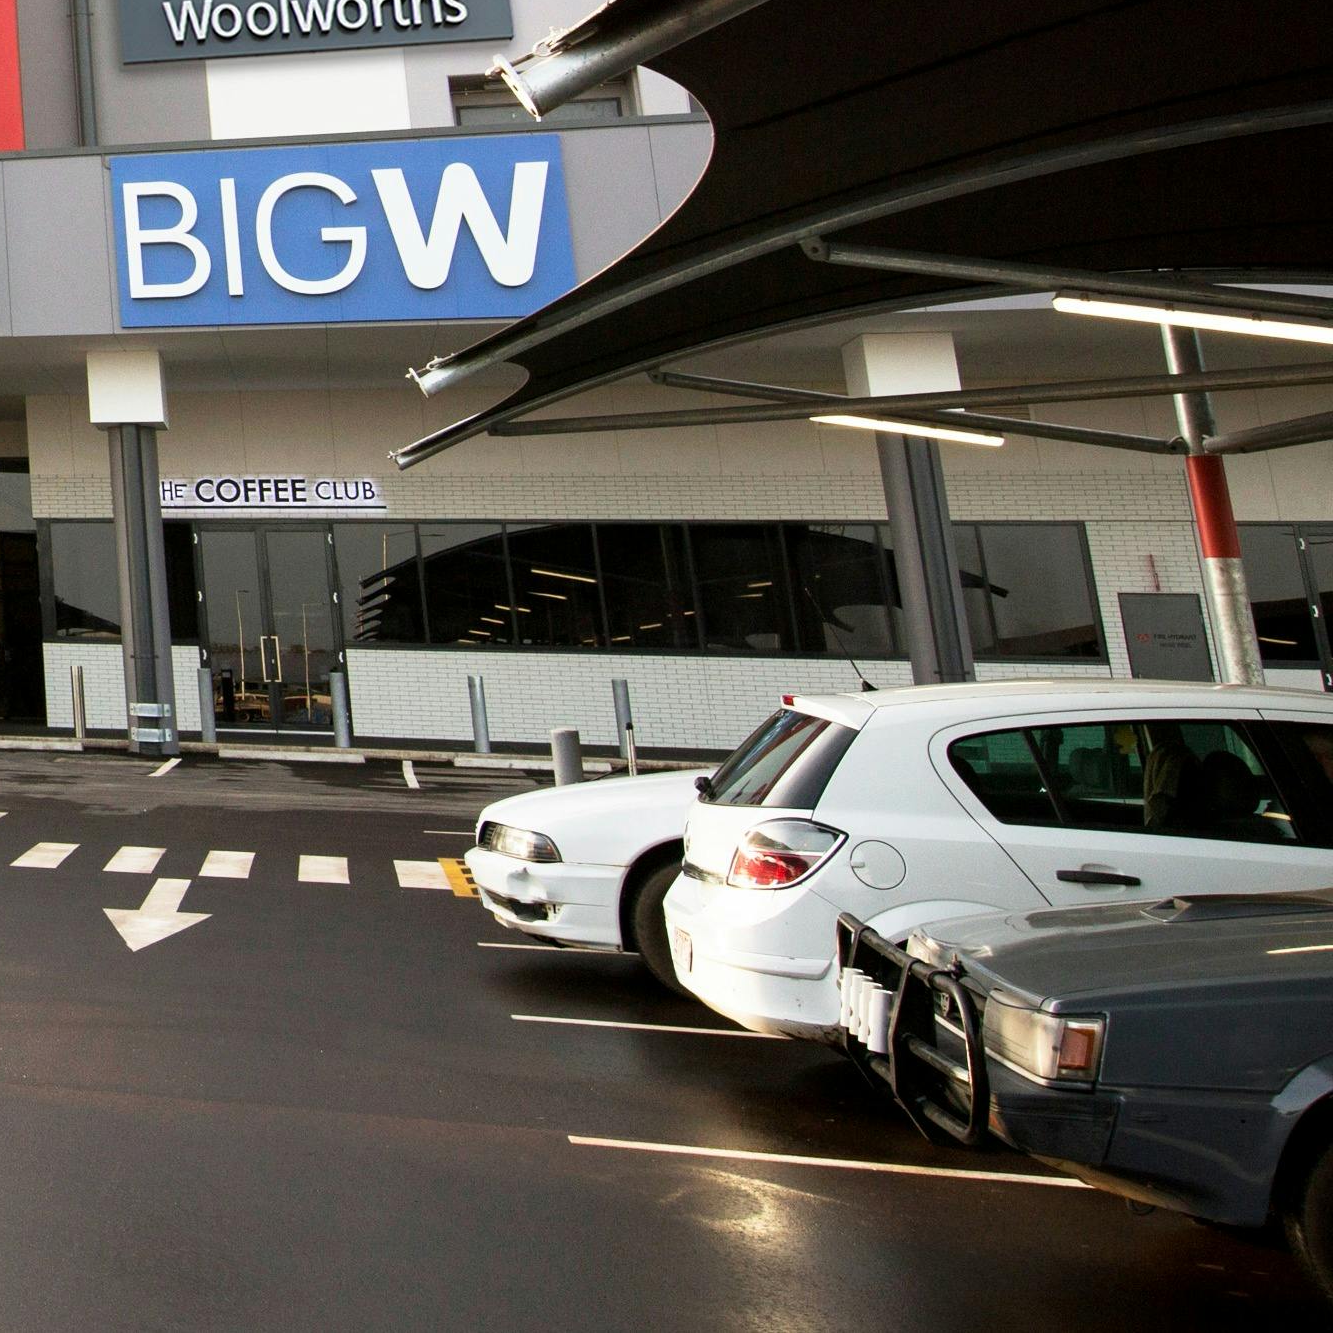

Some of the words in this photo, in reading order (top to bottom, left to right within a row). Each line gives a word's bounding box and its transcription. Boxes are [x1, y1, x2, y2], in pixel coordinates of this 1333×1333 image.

[161, 480, 187, 501] HE
[194, 478, 307, 503] COFFEE
[315, 481, 376, 500] CLUB
